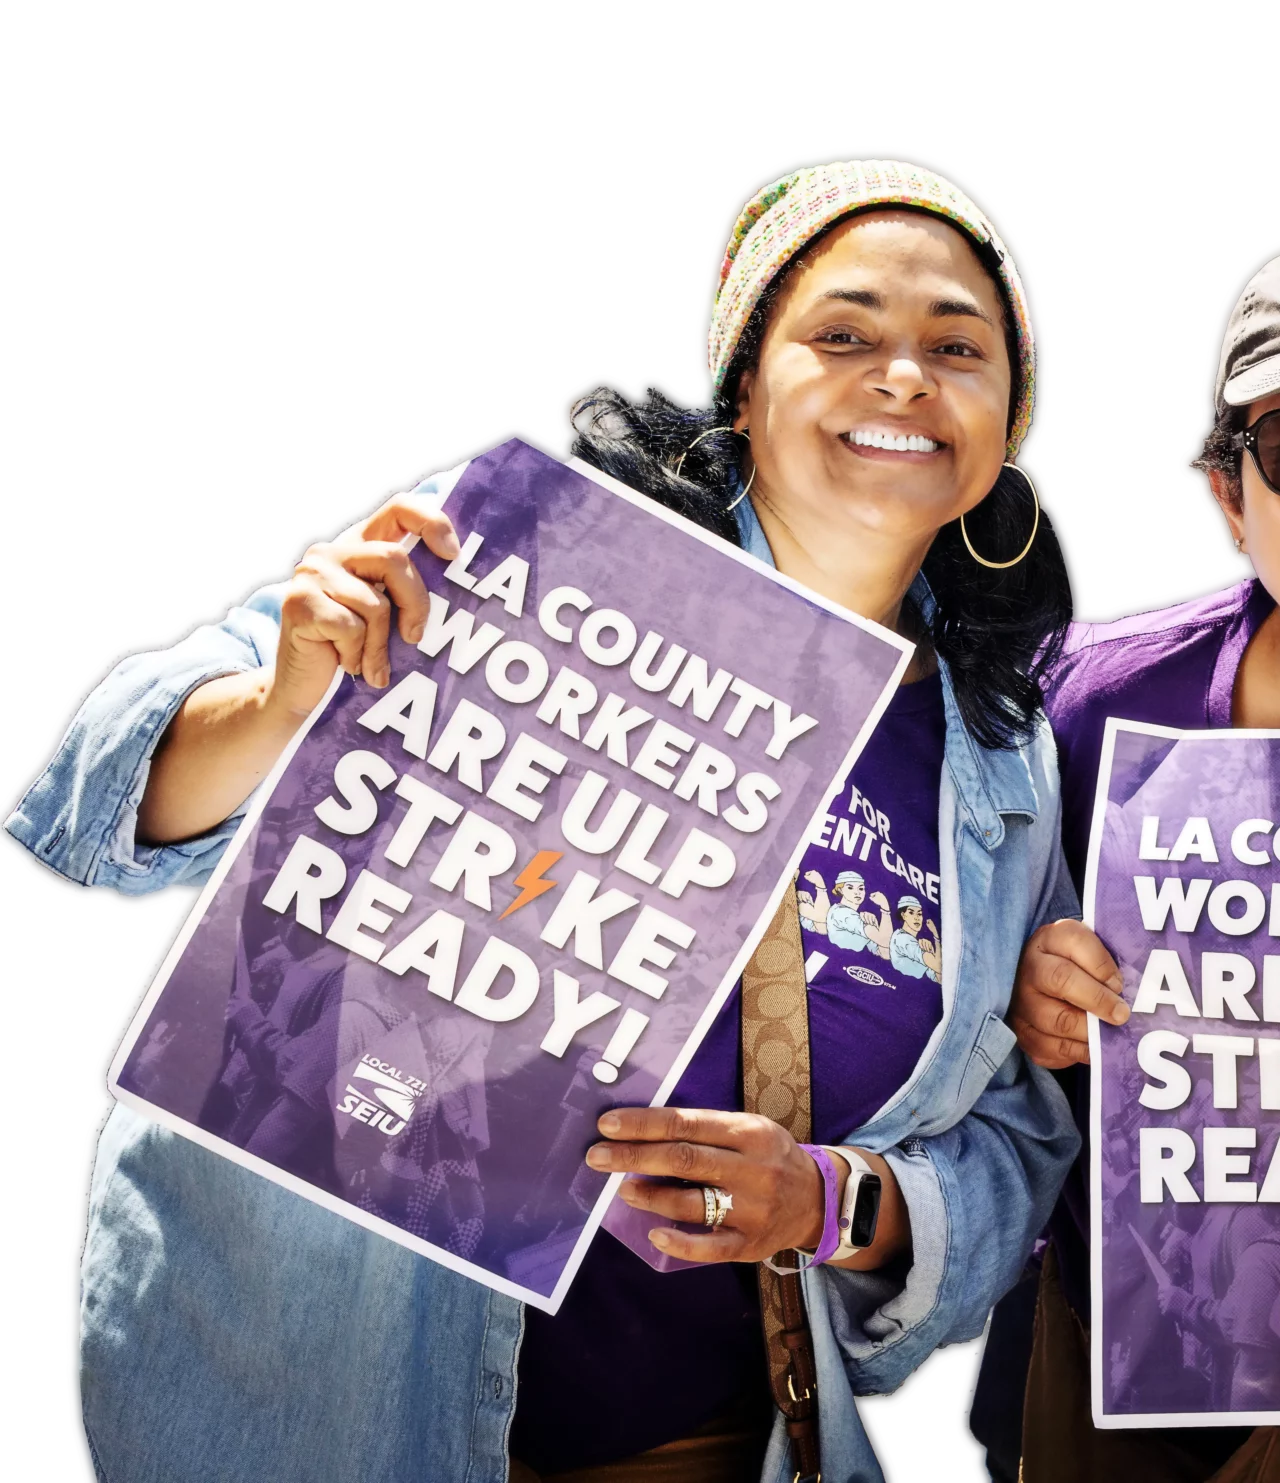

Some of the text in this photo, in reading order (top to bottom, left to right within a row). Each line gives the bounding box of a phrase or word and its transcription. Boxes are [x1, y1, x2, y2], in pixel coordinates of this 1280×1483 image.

[444, 531, 818, 760] LA COUNTY
[416, 591, 781, 833] WORKERS
[359, 669, 736, 899] ARE ULP
[848, 784, 892, 844] FOR
[1138, 815, 1218, 863] LA
[880, 842, 940, 905] CARE
[262, 835, 650, 1084] READY!
[361, 1054, 427, 1091] LOCAL 721
[336, 1095, 407, 1136] SEIU
